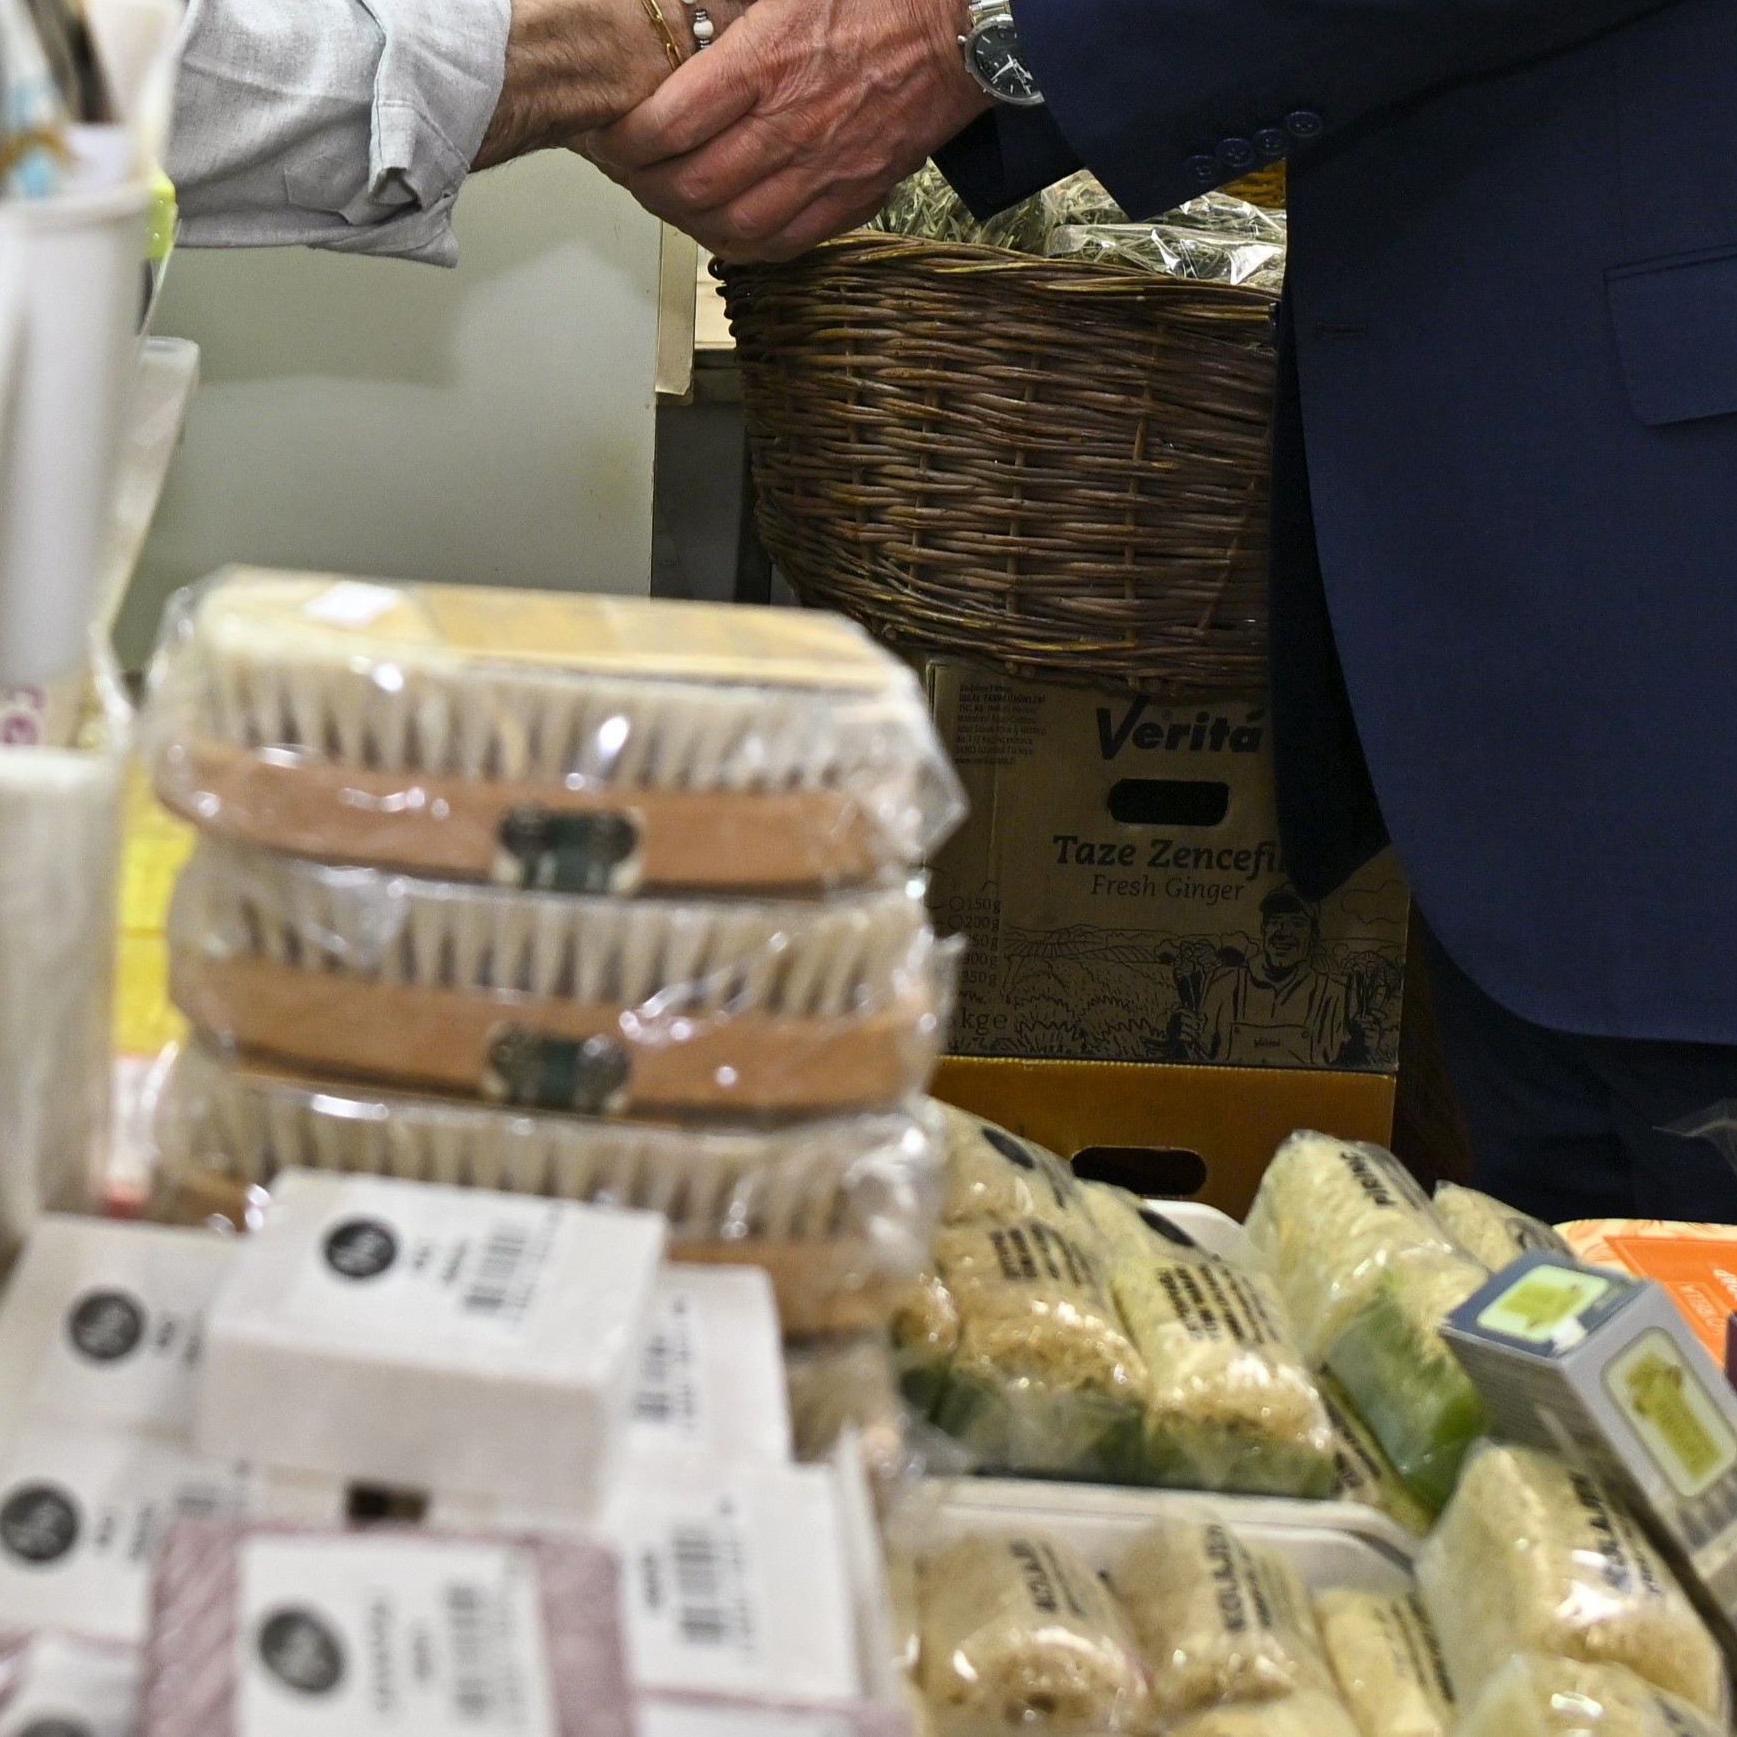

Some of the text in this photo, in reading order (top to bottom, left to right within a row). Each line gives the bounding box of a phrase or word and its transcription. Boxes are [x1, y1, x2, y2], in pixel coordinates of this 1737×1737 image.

[1052, 834, 1137, 867] Taze
[1091, 874, 1246, 905] Fresh Ginger
[964, 915, 1000, 932] 200g
[967, 934, 999, 952] 50g
